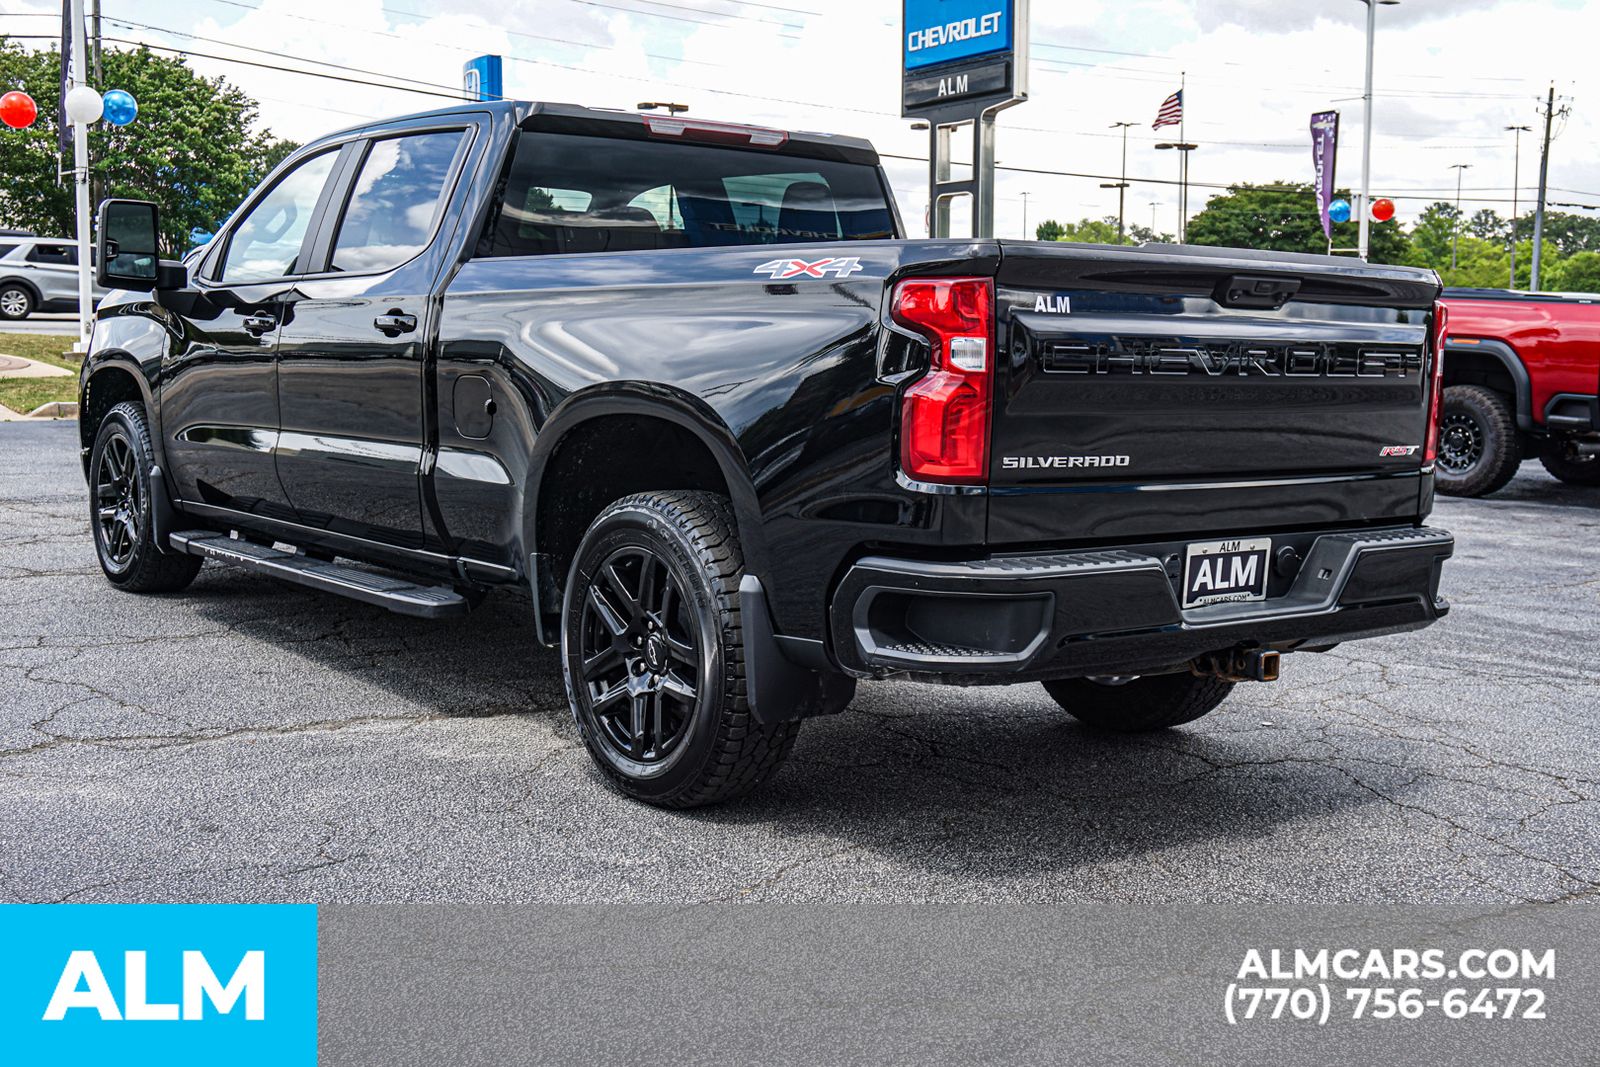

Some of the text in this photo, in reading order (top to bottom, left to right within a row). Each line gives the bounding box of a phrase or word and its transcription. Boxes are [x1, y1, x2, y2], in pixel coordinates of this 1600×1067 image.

[908, 11, 1002, 52] CHEVROLET
[938, 74, 969, 97] ALM
[1034, 295, 1071, 314] ALM
[1042, 340, 1421, 378] CHEVROLET
[1379, 445, 1420, 457] RST
[1002, 455, 1130, 469] SILVERADO
[1219, 541, 1241, 553] ALM
[1191, 555, 1258, 592] ALM
